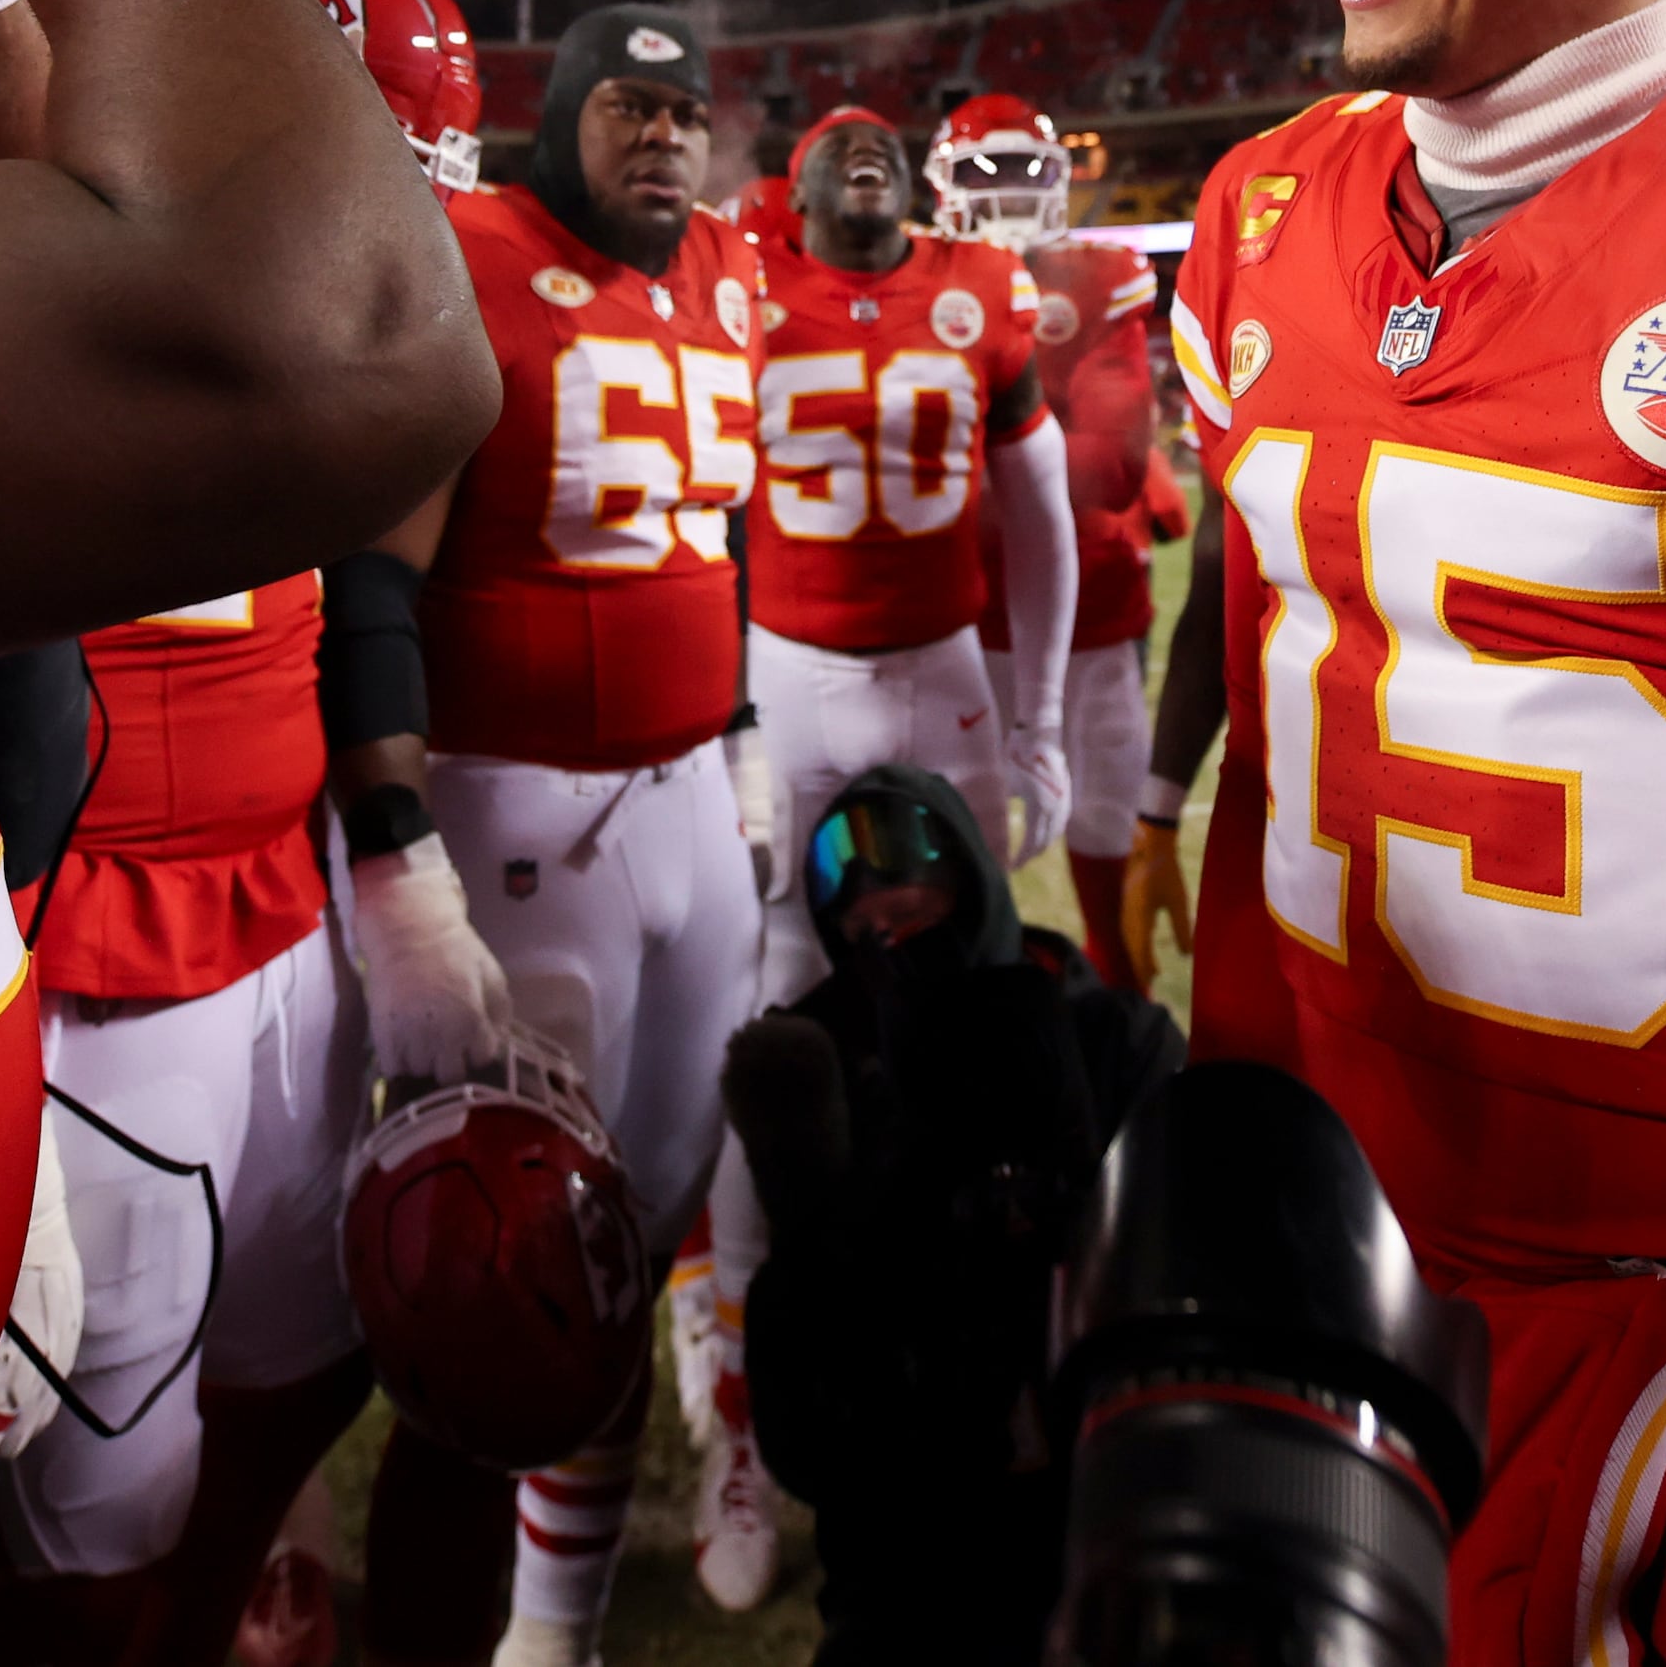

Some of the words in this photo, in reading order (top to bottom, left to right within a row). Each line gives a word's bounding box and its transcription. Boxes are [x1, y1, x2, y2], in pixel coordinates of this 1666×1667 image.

[1239, 175, 1297, 239] C
[1387, 331, 1420, 361] NFL
[541, 334, 757, 572] 65
[758, 349, 979, 542] 50
